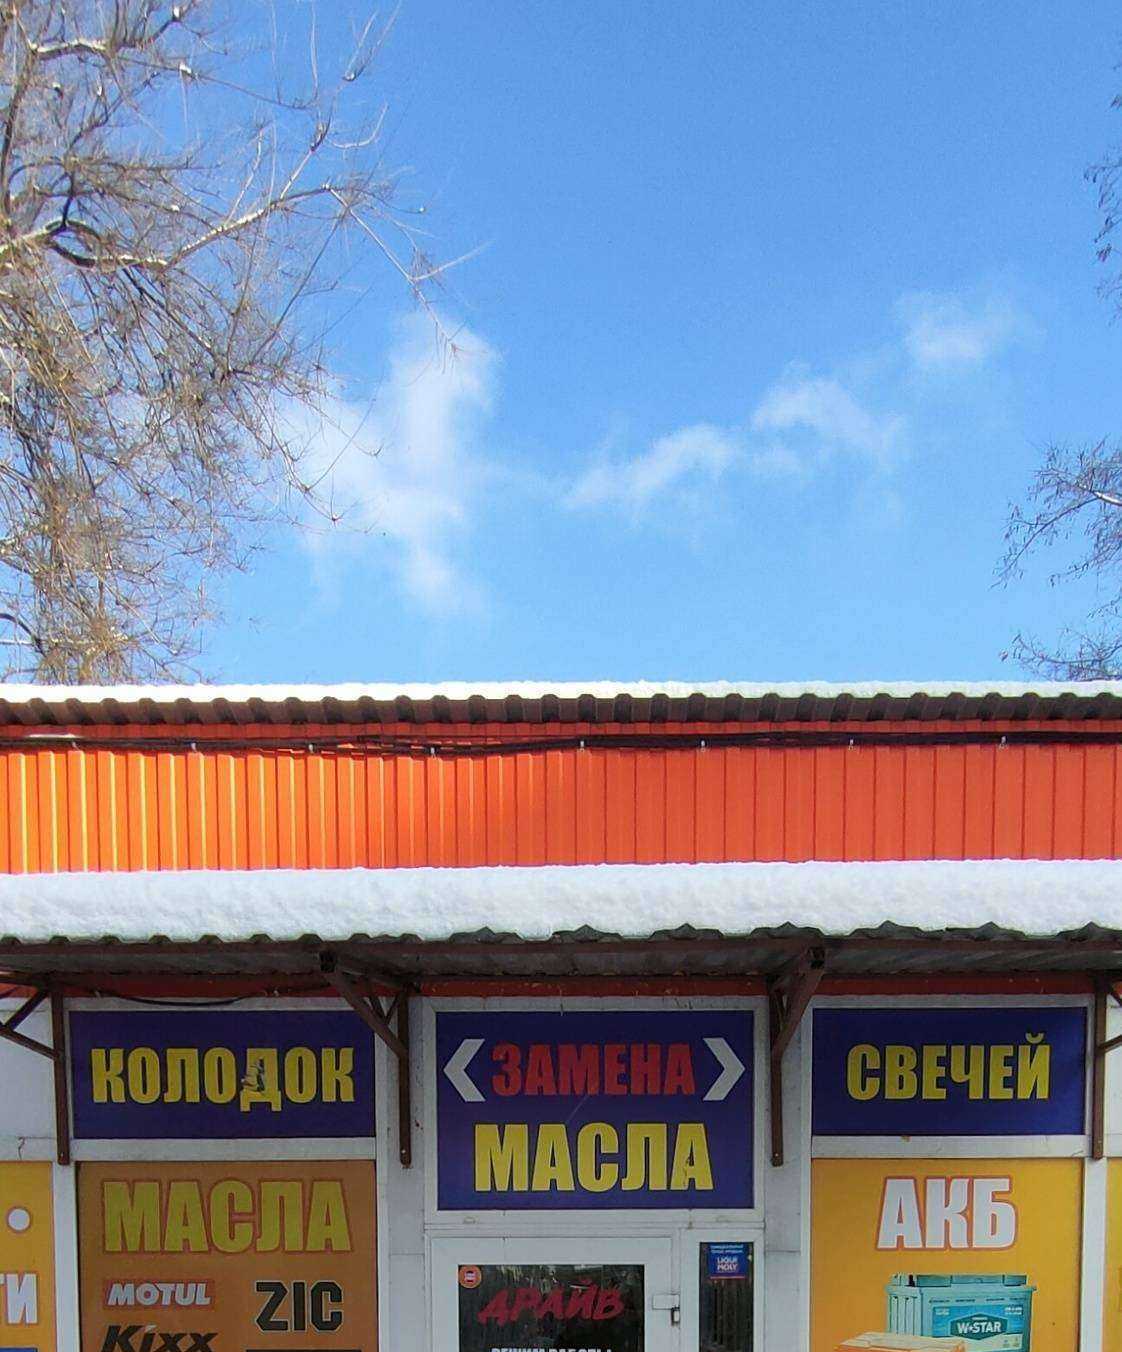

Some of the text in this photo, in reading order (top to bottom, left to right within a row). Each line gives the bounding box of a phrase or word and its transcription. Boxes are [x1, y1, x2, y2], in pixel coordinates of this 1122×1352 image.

[91, 1047, 355, 1112] КОЛОДОК
[491, 1043, 696, 1096] ЗАМЕНА
[846, 1033, 1050, 1101] СВЕЧЕЙ
[474, 1122, 714, 1192] МАСЛА
[103, 1178, 352, 1254] МАСЛА
[877, 1177, 1016, 1249] АКБ
[107, 1282, 211, 1307] MOTUL
[255, 1280, 344, 1332] ZIC
[477, 1279, 624, 1328] ДРАЙВ
